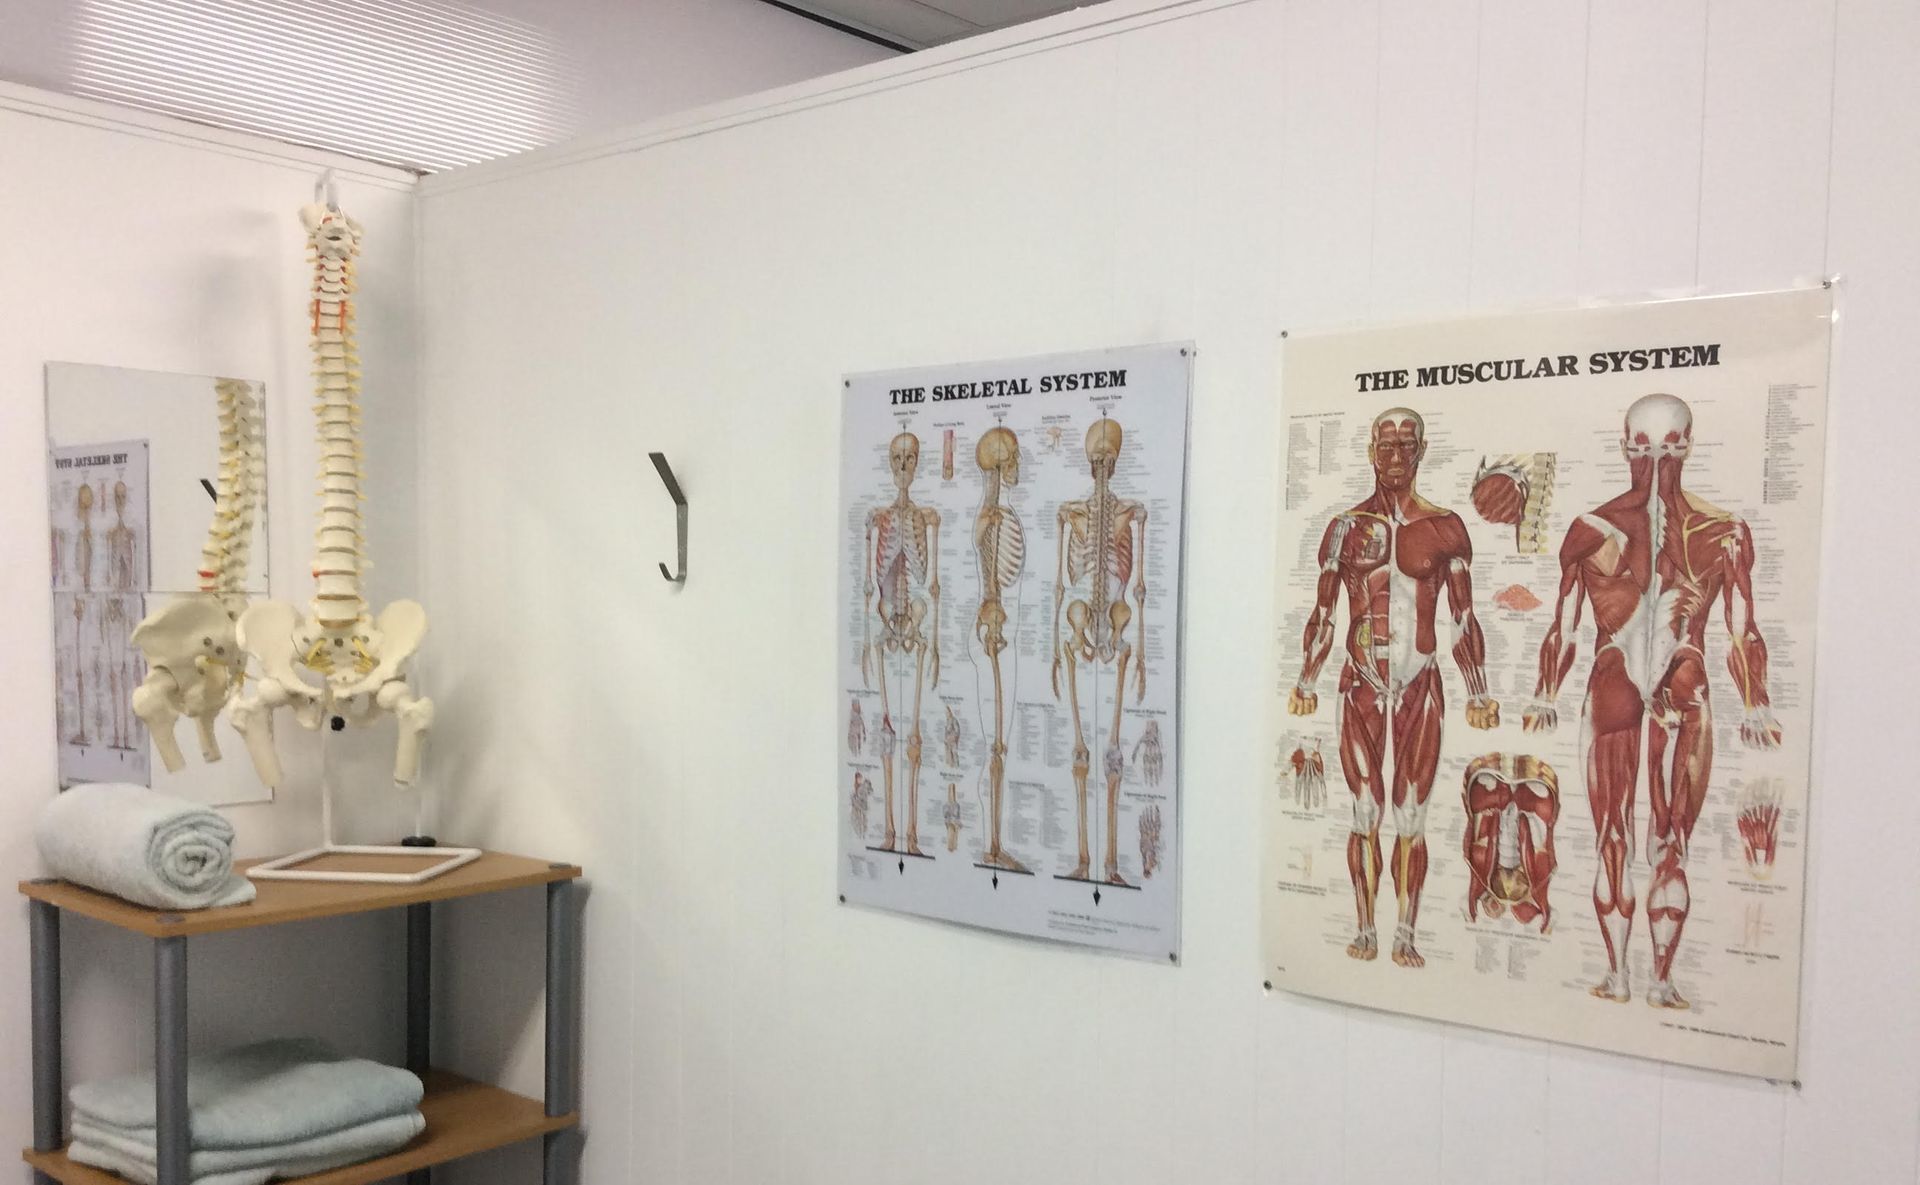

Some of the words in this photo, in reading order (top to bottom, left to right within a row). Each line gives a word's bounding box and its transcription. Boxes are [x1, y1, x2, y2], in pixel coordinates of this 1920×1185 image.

[889, 387, 926, 405] THE
[932, 378, 1033, 402] SKELETAL
[1039, 369, 1128, 393] SYSTEM
[1354, 370, 1410, 393] THE
[1416, 355, 1581, 388] MUSCULAR
[1589, 343, 1721, 375] SYSTEM
